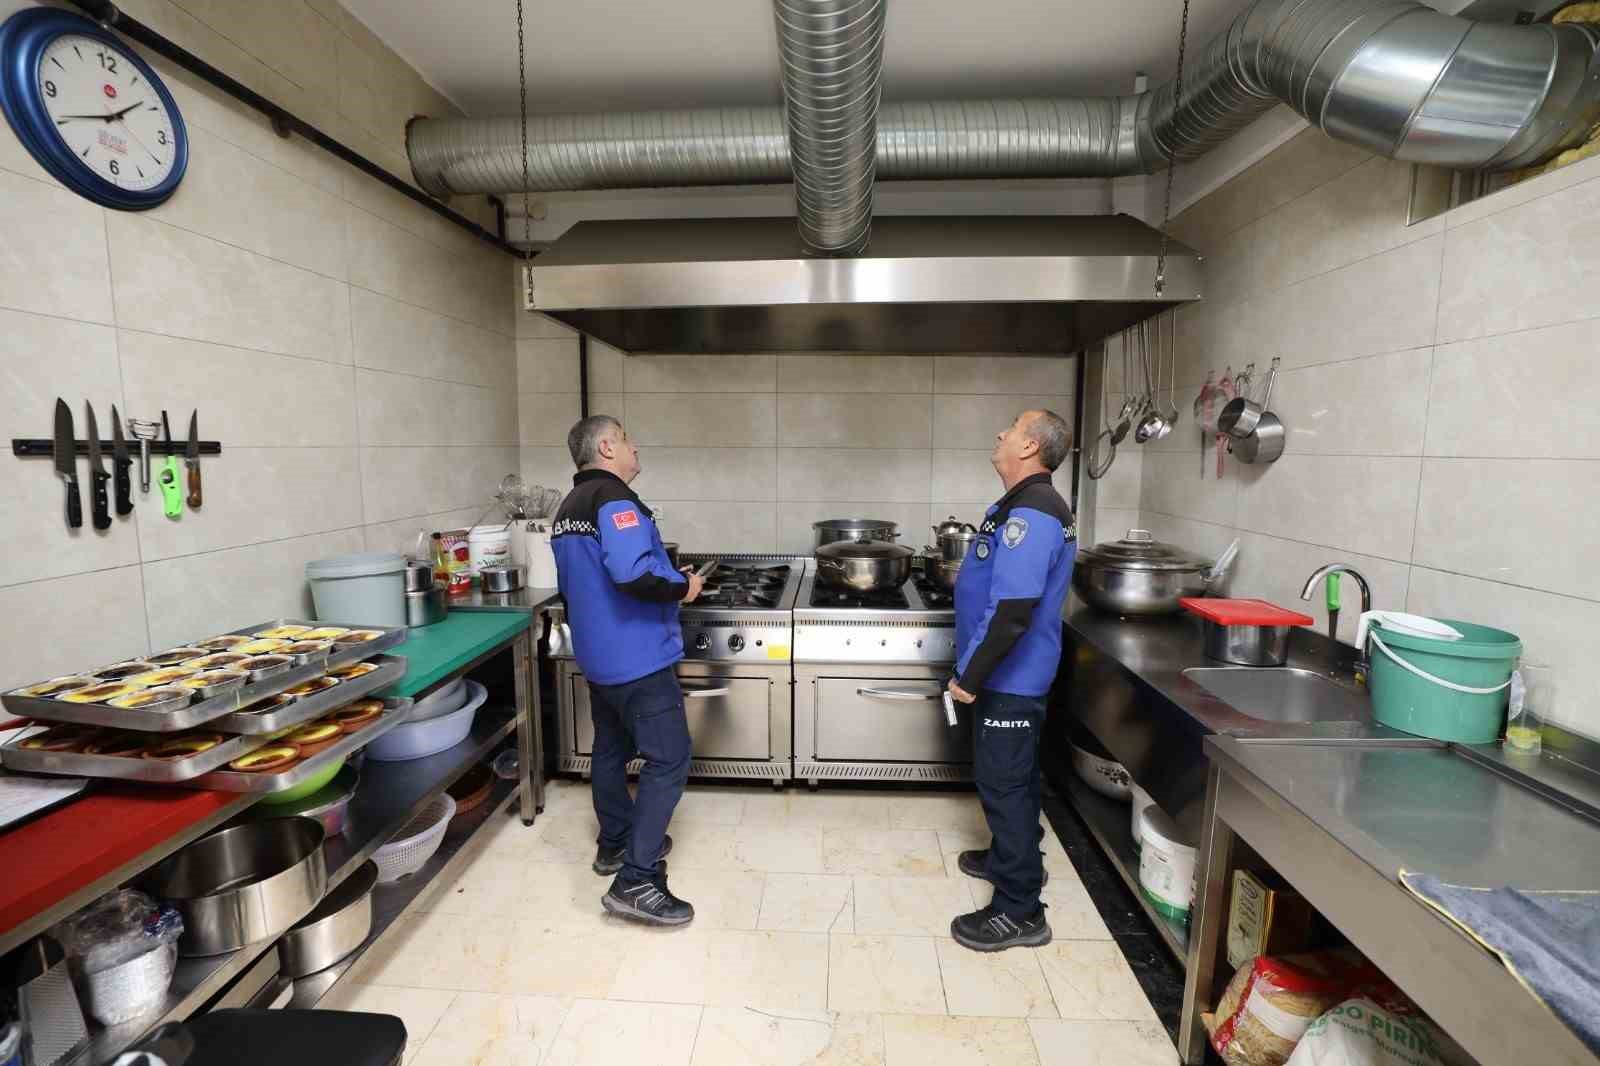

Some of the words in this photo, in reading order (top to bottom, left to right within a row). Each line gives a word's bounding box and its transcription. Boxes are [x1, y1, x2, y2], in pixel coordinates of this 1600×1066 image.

[98, 53, 118, 74] 12
[44, 80, 57, 98] 9
[157, 130, 168, 146] 3
[109, 159, 120, 176] 6
[983, 718, 1030, 728] ZABITA
